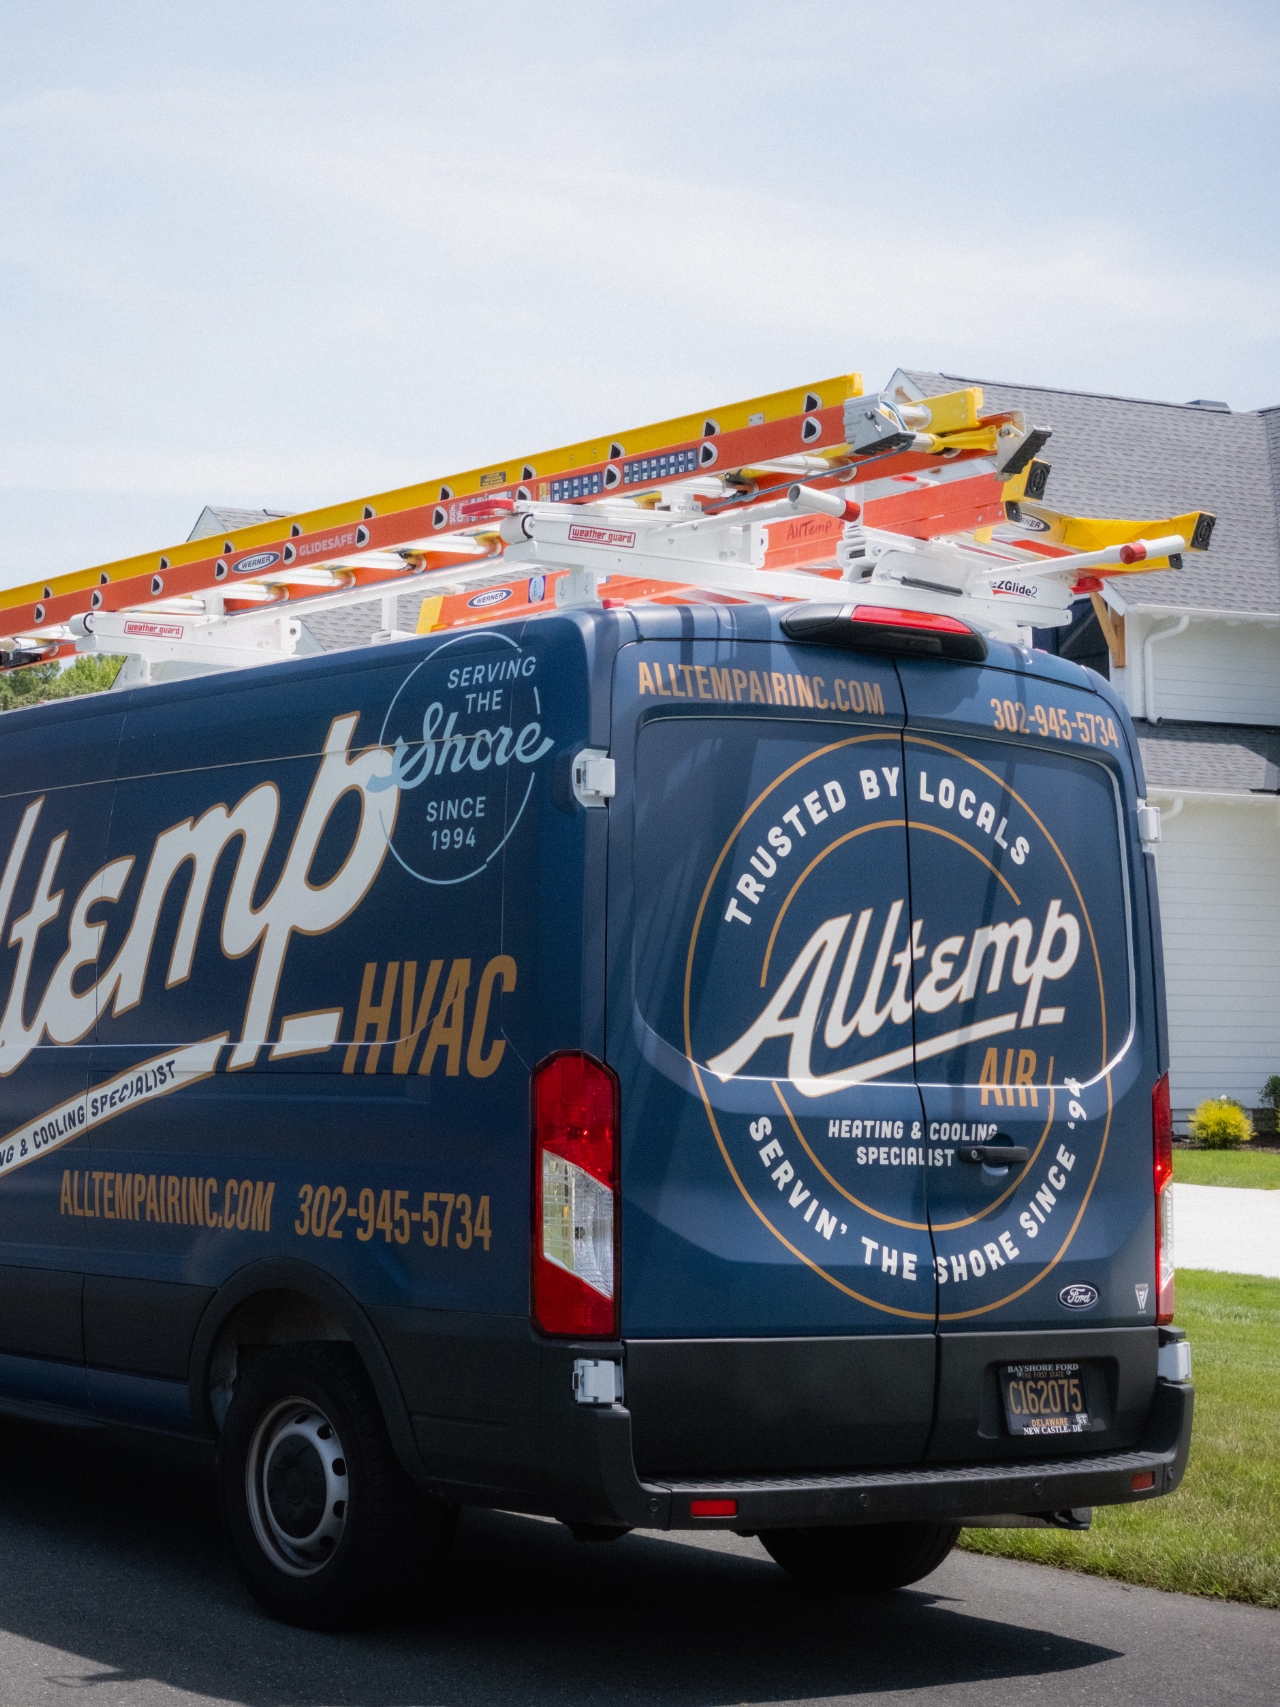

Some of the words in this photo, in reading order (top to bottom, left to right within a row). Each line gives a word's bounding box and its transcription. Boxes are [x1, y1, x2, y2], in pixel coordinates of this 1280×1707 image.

[572, 528, 607, 540] weather
[608, 533, 632, 543] guard
[1020, 517, 1042, 529] RNER
[299, 533, 353, 556] GLIDESAFE
[241, 555, 271, 569] WERNER
[476, 592, 504, 604] WERNER
[127, 623, 157, 633] weather
[159, 627, 181, 635] guard
[447, 656, 537, 689] SERVING
[465, 689, 503, 714] THE
[638, 662, 885, 716] ALLTEMPAIRINC.COM
[989, 698, 1119, 749] 302-945-5734
[365, 702, 555, 794] Shore
[426, 796, 486, 822] SINCE
[431, 827, 476, 850] 1994
[724, 780, 847, 925] TRUSTED
[859, 767, 900, 800] BY
[920, 771, 1030, 865] LOCALS
[706, 899, 1080, 1098] Alltemp
[342, 954, 518, 1079] HVAC
[980, 1047, 1039, 1107] AIR
[20, 1138, 28, 1157] &
[32, 1106, 85, 1150] COOLING
[91, 1060, 176, 1117] SPECIALIST
[828, 1120, 904, 1139] HEATING
[910, 1121, 922, 1140] &
[856, 1147, 955, 1167] SPECIALIST
[60, 1170, 276, 1232] ALLTEMPAIRINC.COM
[295, 1184, 492, 1251] 302-945-5734
[749, 1116, 848, 1241] SERVIN'
[861, 1236, 918, 1281] THE
[933, 1231, 1020, 1284] SHORE
[1019, 1144, 1077, 1239] SINCE
[1067, 1287, 1091, 1304] Ford
[1007, 1364, 1054, 1373] BAYSHORE
[1055, 1363, 1079, 1371] FORD
[1009, 1378, 1083, 1414] C162075
[1023, 1427, 1041, 1435] NEW
[1072, 1424, 1083, 1432] DE
[1031, 1417, 1069, 1427] DELAWARE
